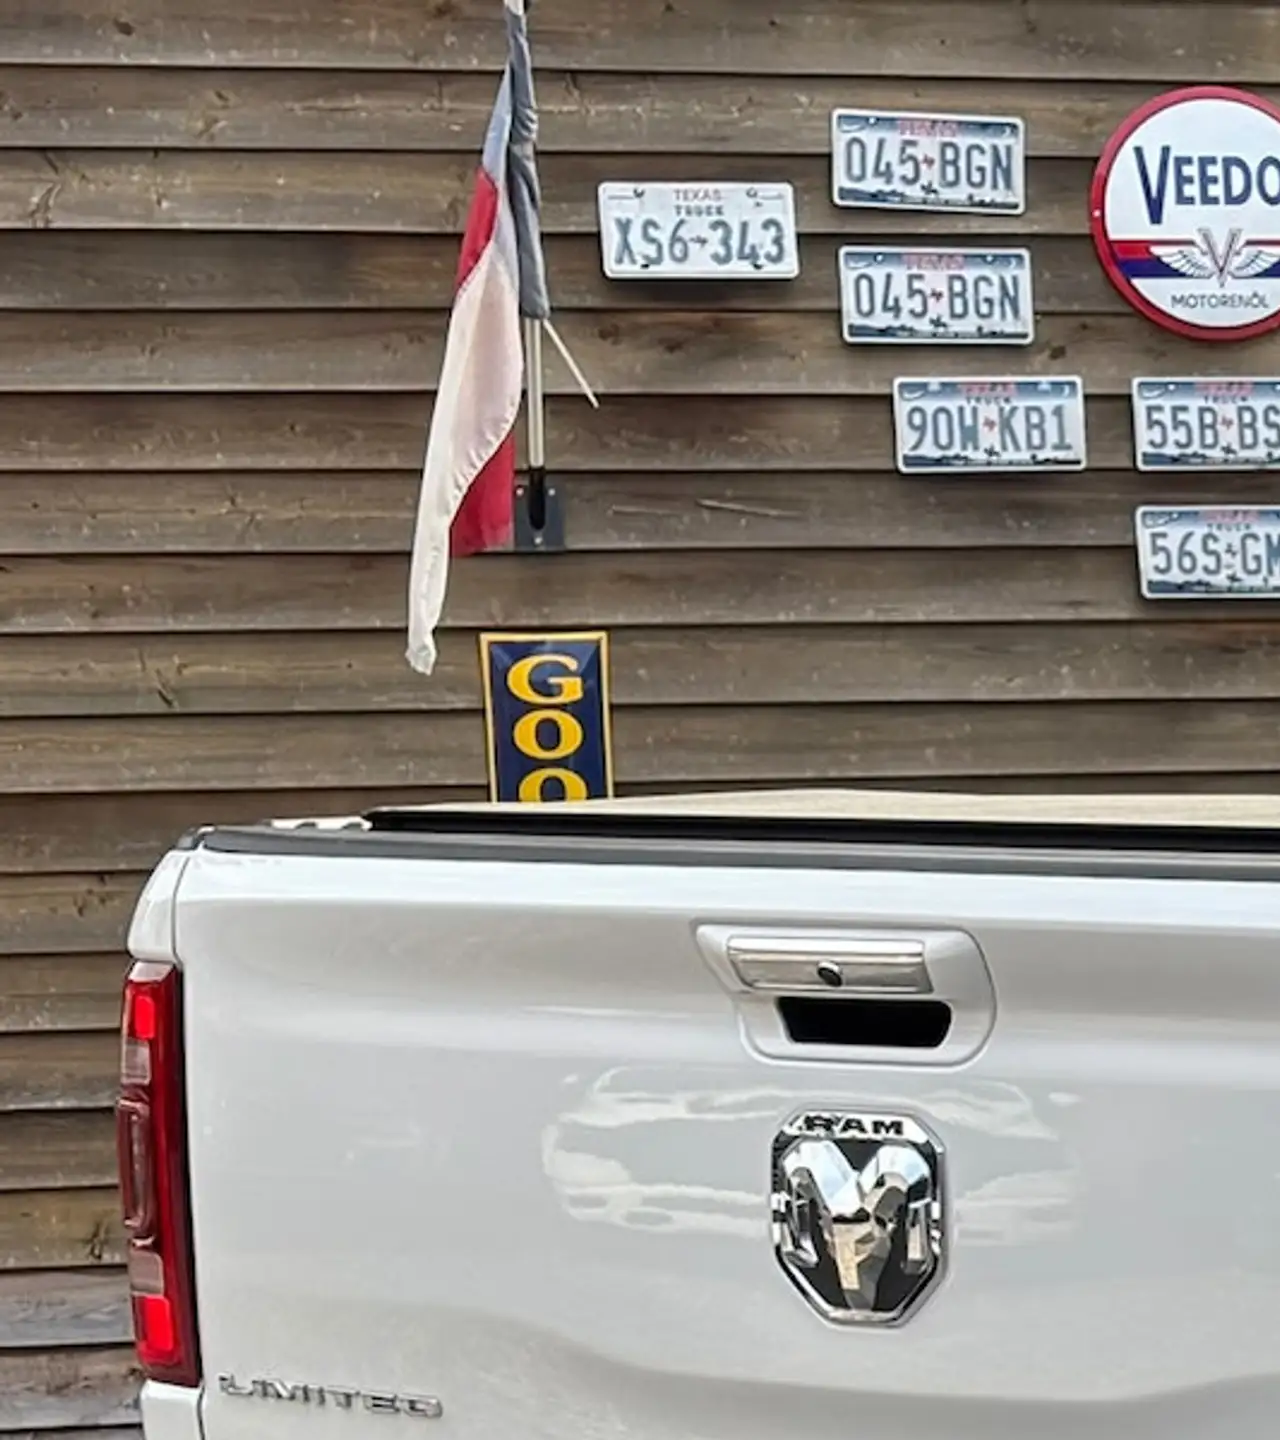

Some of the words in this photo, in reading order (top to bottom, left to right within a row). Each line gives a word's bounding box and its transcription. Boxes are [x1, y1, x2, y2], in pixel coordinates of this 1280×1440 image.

[845, 136, 921, 186] 045
[938, 141, 1013, 191] BGN
[614, 217, 689, 265] XS6
[708, 218, 785, 265] 343
[854, 272, 928, 319] 045
[947, 273, 1021, 320] BGN
[1145, 404, 1219, 449] 55B
[803, 1115, 904, 1135] RAM
[218, 1373, 444, 1419] LIMITED
